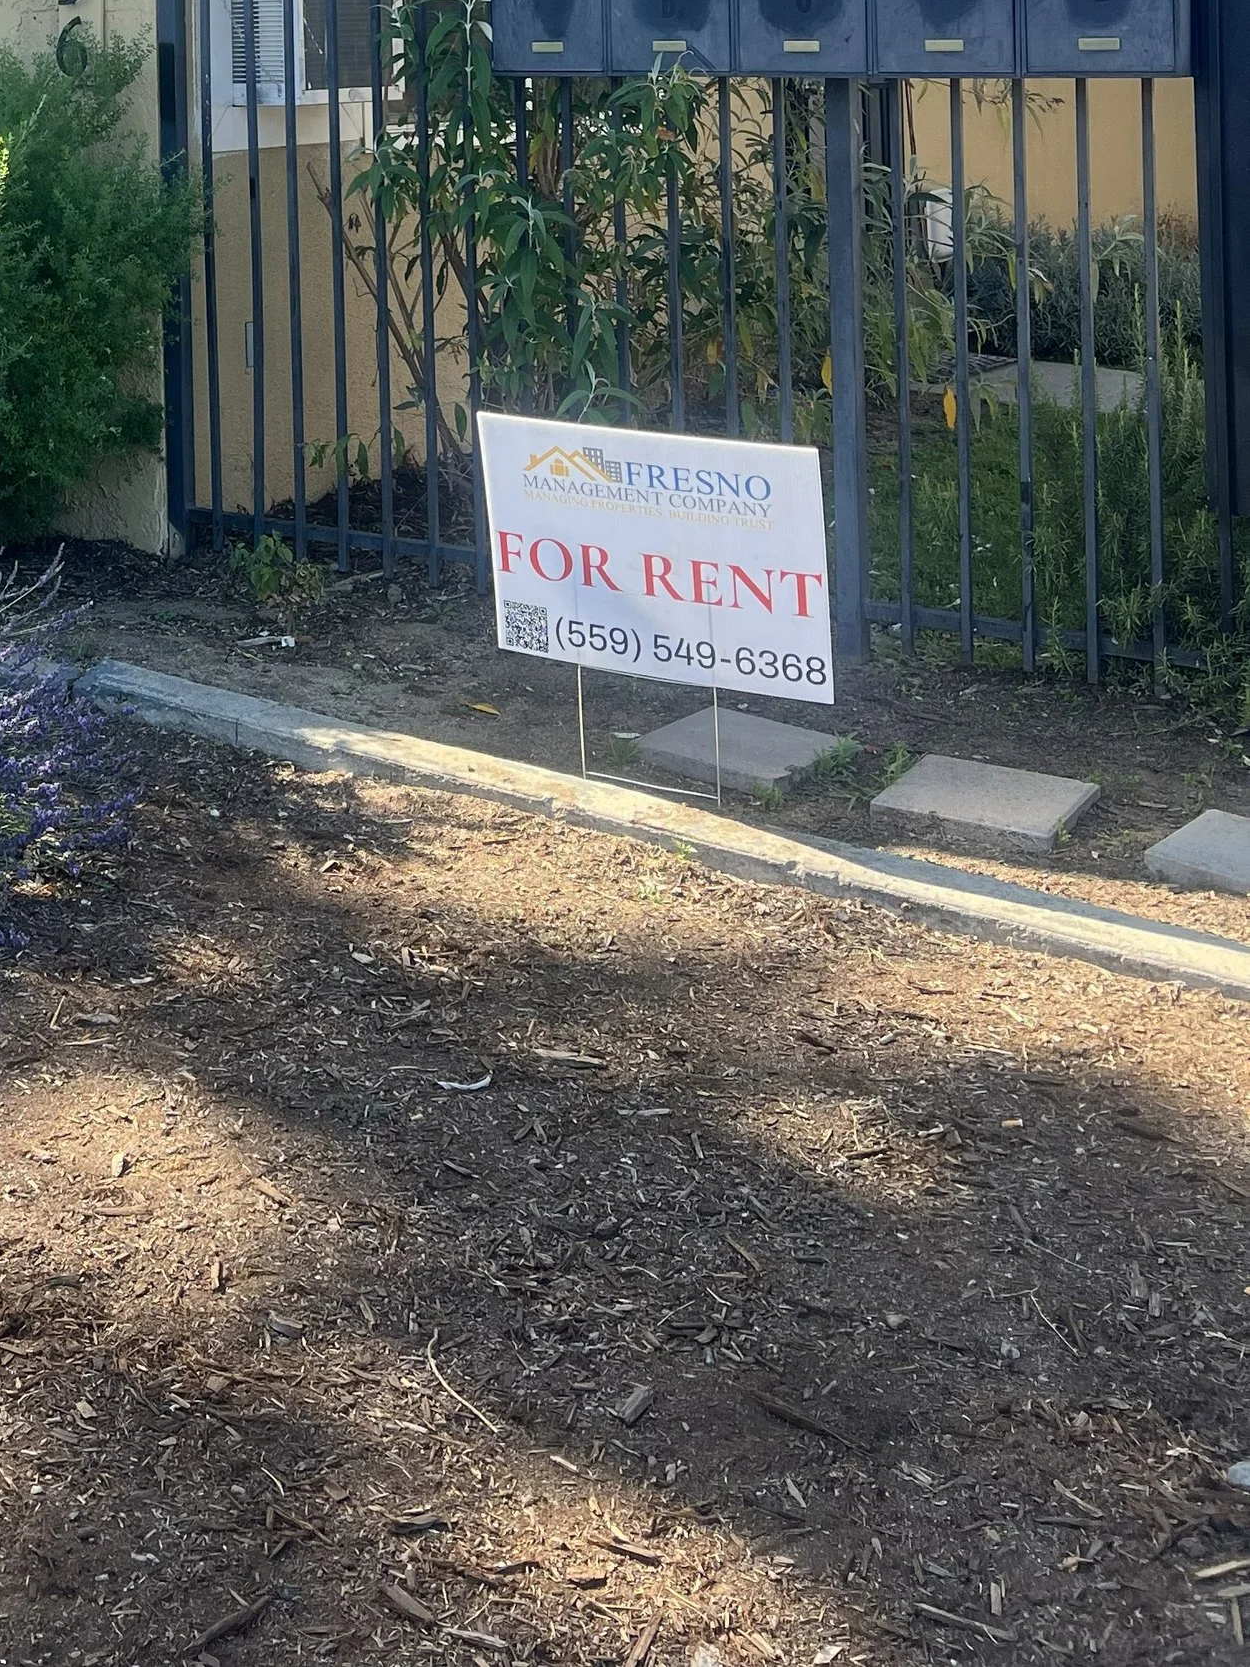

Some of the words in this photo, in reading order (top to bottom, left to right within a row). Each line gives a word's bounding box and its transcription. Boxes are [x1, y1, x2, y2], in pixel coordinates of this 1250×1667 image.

[523, 474, 662, 506] MANAGEMENT
[669, 493, 772, 518] COMPANY
[625, 461, 771, 501] FRESNO
[524, 489, 589, 508] MANAGING
[669, 509, 729, 527] BUILDING
[732, 516, 774, 531] TRUST
[497, 530, 624, 593] FOR
[641, 552, 823, 619] RENT
[555, 615, 642, 663] (559)
[653, 634, 828, 686] 549-6368
